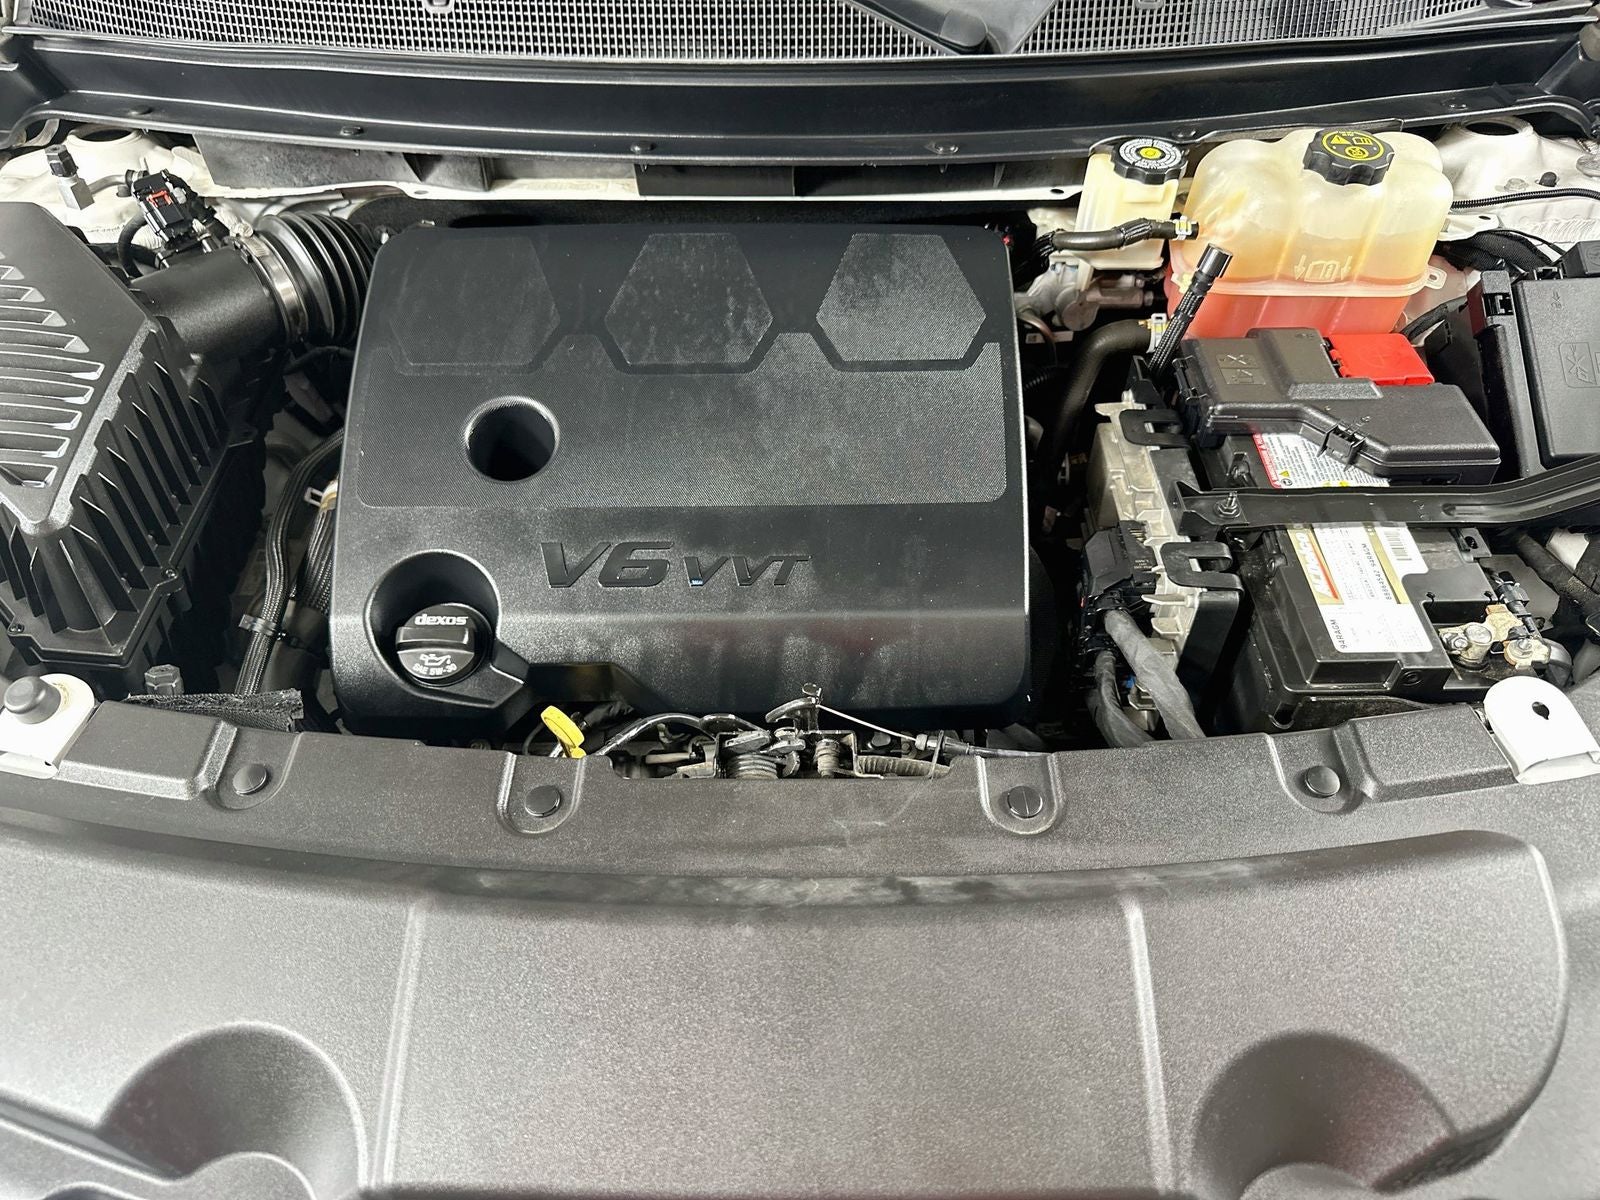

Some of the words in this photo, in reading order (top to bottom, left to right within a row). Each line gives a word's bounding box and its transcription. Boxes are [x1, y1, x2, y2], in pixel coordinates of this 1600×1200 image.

[541, 542, 674, 588] V6
[684, 555, 812, 587] VVT
[415, 613, 469, 626] dexos
[1330, 619, 1348, 649] 94RAGM
[412, 662, 429, 675] SAE
[429, 662, 458, 676] 5W-30
